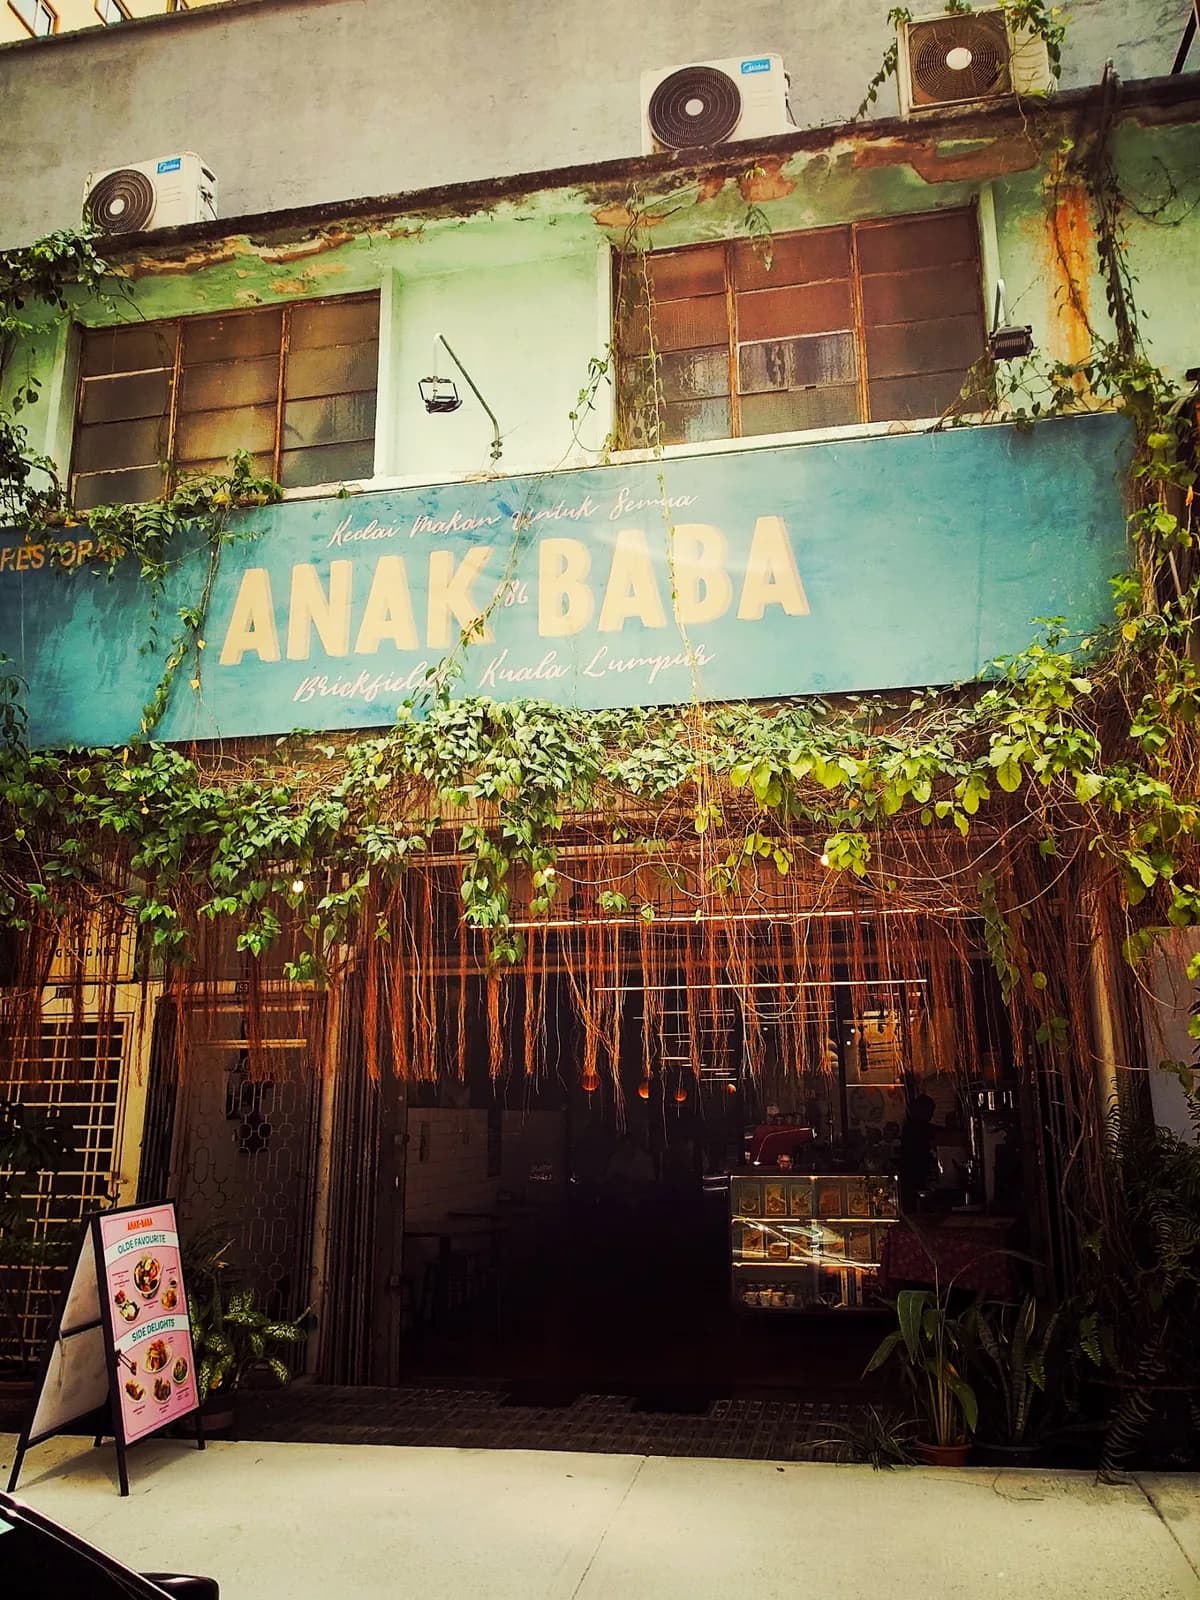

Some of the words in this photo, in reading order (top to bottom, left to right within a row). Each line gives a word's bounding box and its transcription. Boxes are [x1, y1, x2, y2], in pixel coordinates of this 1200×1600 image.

[219, 546, 496, 666] ANAK
[538, 515, 810, 638] BABA
[478, 648, 571, 689] Kuala
[117, 1239, 134, 1254] OLDE
[134, 1234, 167, 1248] FAVOURITE
[131, 1329, 147, 1343] SIDE
[147, 1319, 175, 1335] DELIGHTS
